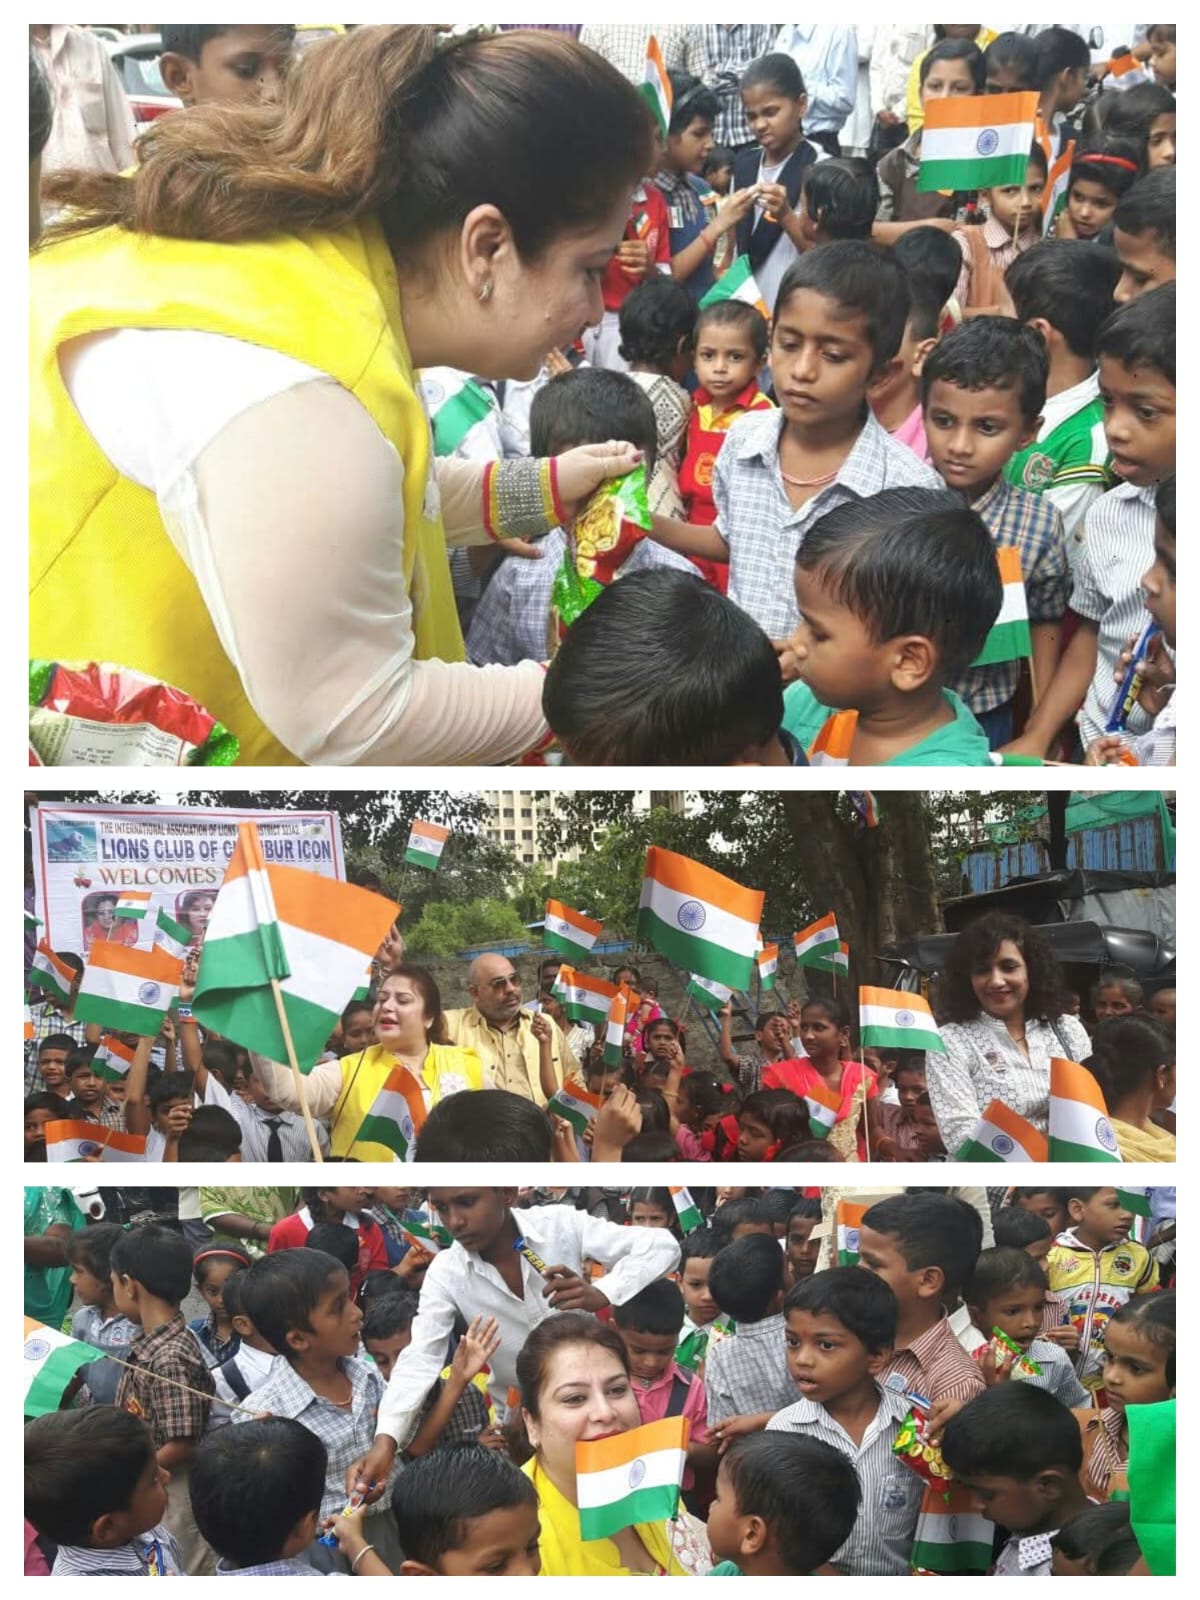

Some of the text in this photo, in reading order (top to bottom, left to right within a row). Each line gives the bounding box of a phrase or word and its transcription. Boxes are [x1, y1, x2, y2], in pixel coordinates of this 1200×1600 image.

[100, 821, 114, 834] THE
[114, 822, 165, 835] INTERNATIONAL
[167, 823, 208, 836] ASSOCIATION
[208, 824, 217, 836] OF
[218, 824, 236, 837] LIONS
[256, 823, 280, 836] ISTRICT
[101, 838, 149, 861] LIONS
[154, 839, 194, 860] CLUB
[199, 840, 218, 860] OF
[298, 839, 332, 860] ICON
[99, 866, 217, 885] WELCOMES
